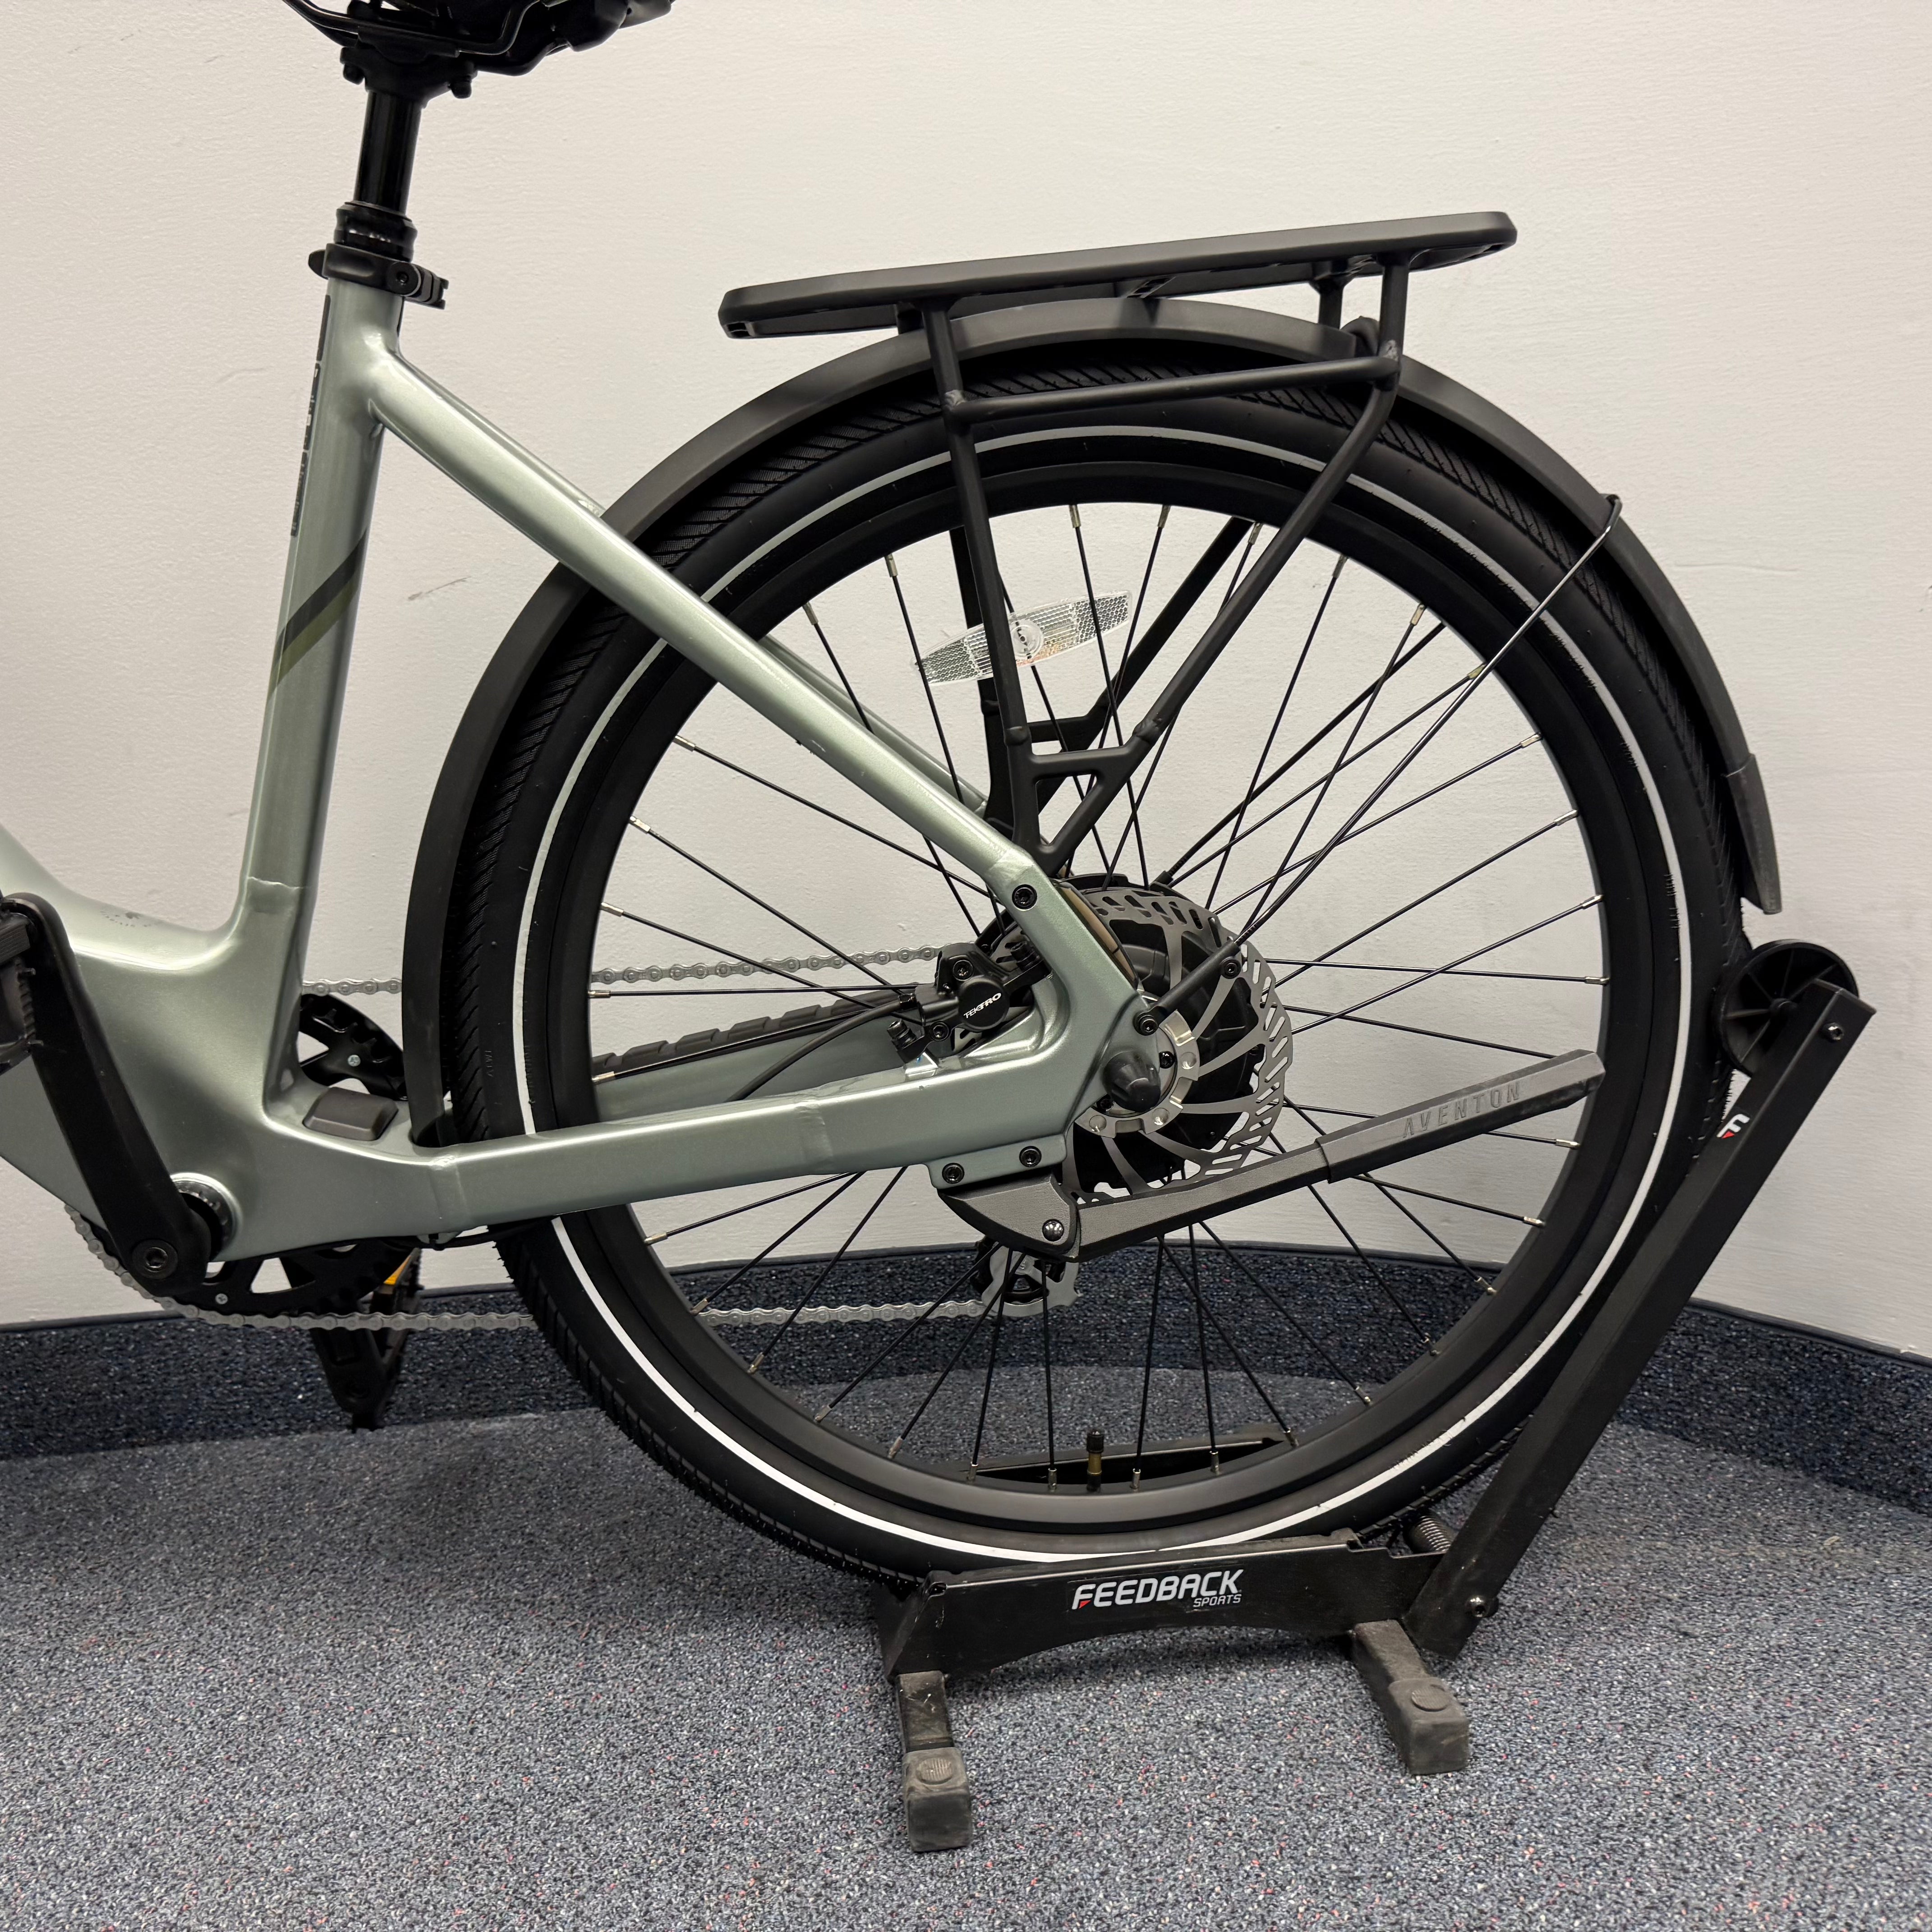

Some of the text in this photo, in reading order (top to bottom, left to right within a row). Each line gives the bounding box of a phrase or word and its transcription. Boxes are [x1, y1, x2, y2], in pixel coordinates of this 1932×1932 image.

[963, 993, 1002, 1019] TEKTRO
[1403, 1081, 1520, 1139] AVENTON
[1071, 1569, 1244, 1610] FEEDBACK
[1193, 1594, 1242, 1608] SPORTS
